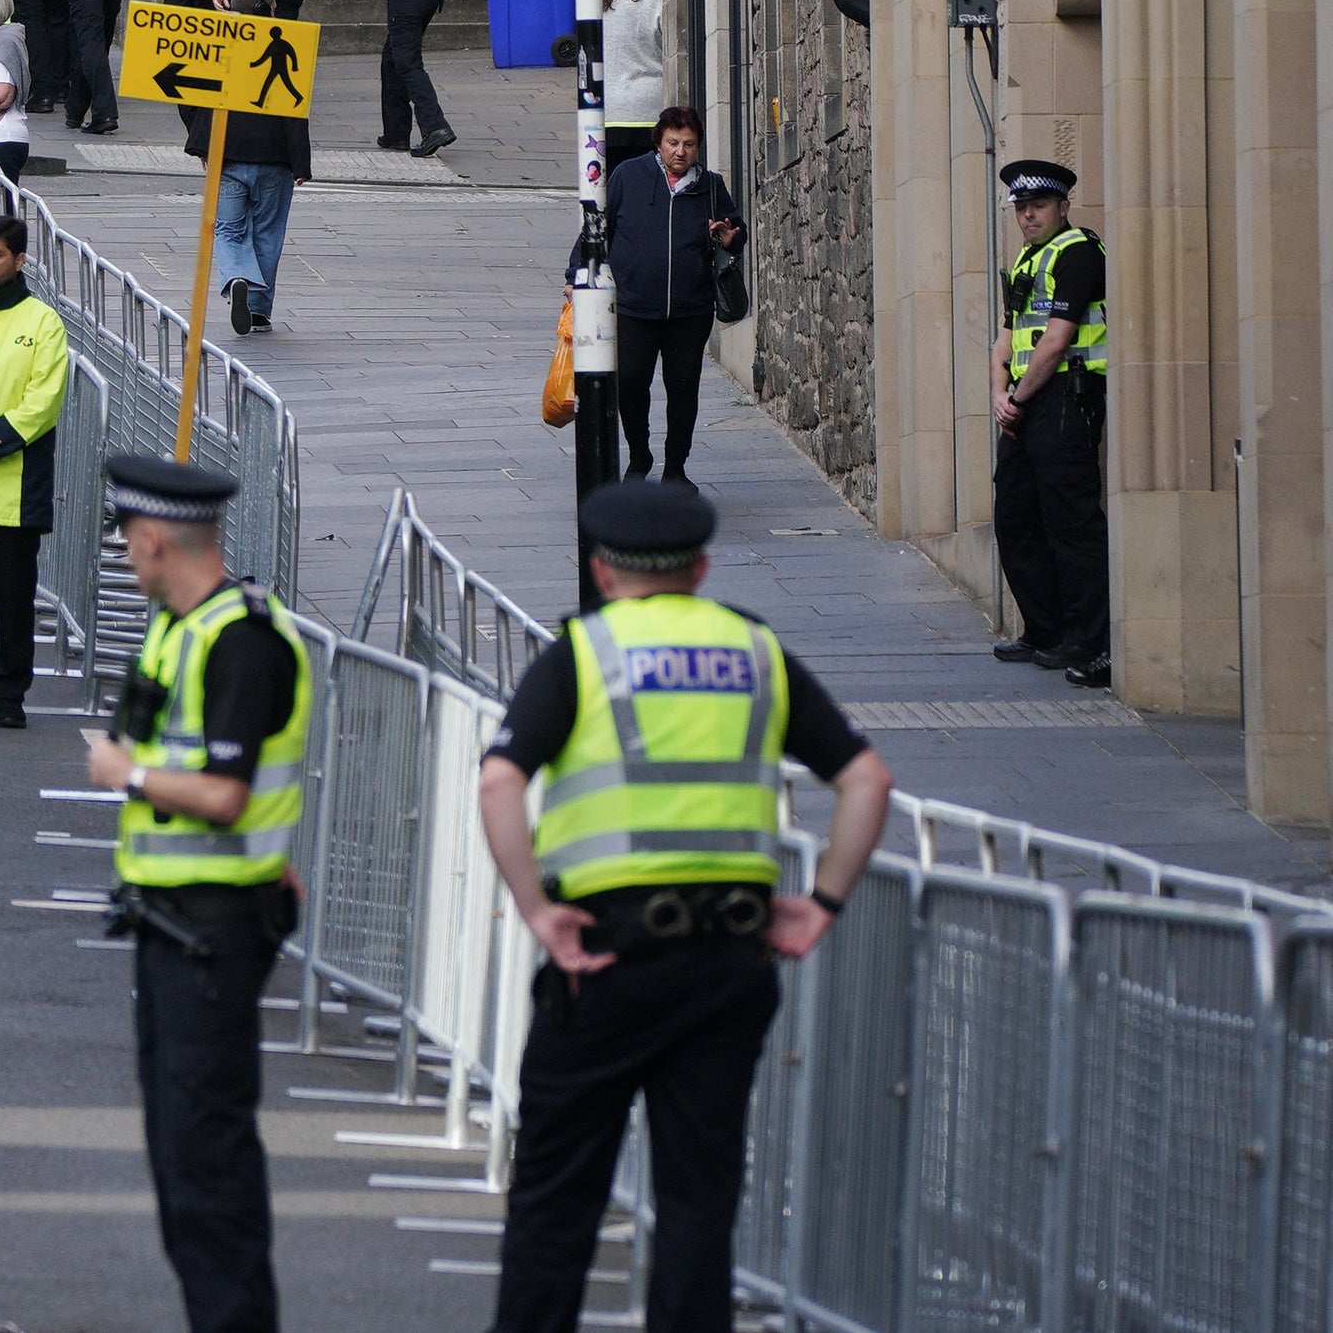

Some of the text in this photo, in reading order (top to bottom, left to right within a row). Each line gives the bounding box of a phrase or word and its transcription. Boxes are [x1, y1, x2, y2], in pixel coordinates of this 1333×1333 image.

[133, 9, 256, 41] CROSSING
[156, 38, 226, 62] POINT
[633, 649, 752, 688] POLICE
